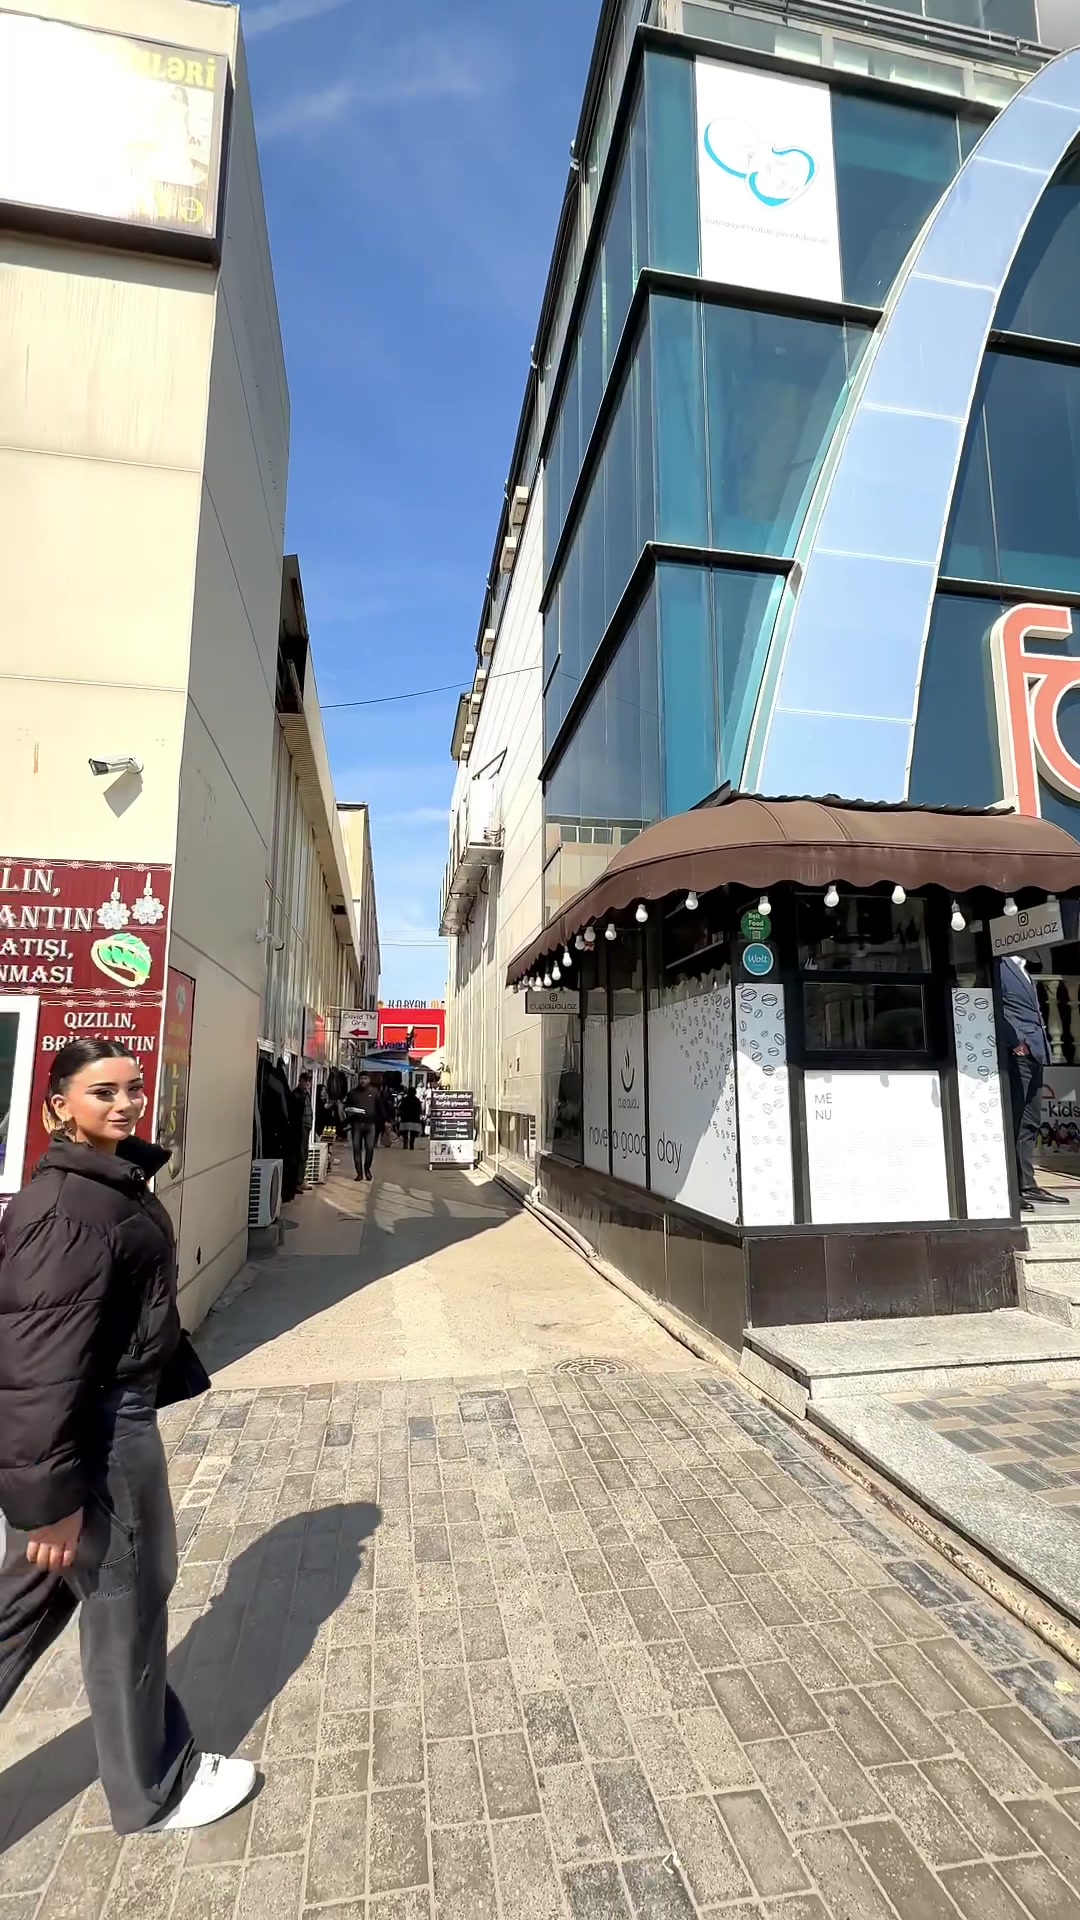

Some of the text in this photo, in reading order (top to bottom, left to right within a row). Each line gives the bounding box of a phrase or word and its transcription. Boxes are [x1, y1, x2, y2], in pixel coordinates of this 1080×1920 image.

[748, 919, 764, 927] Food
[748, 954, 768, 964] Wolt
[64, 1011, 136, 1031] QIZILIN,
[814, 1093, 832, 1104] ME
[815, 1109, 832, 1120] NU
[656, 1131, 682, 1174] day
